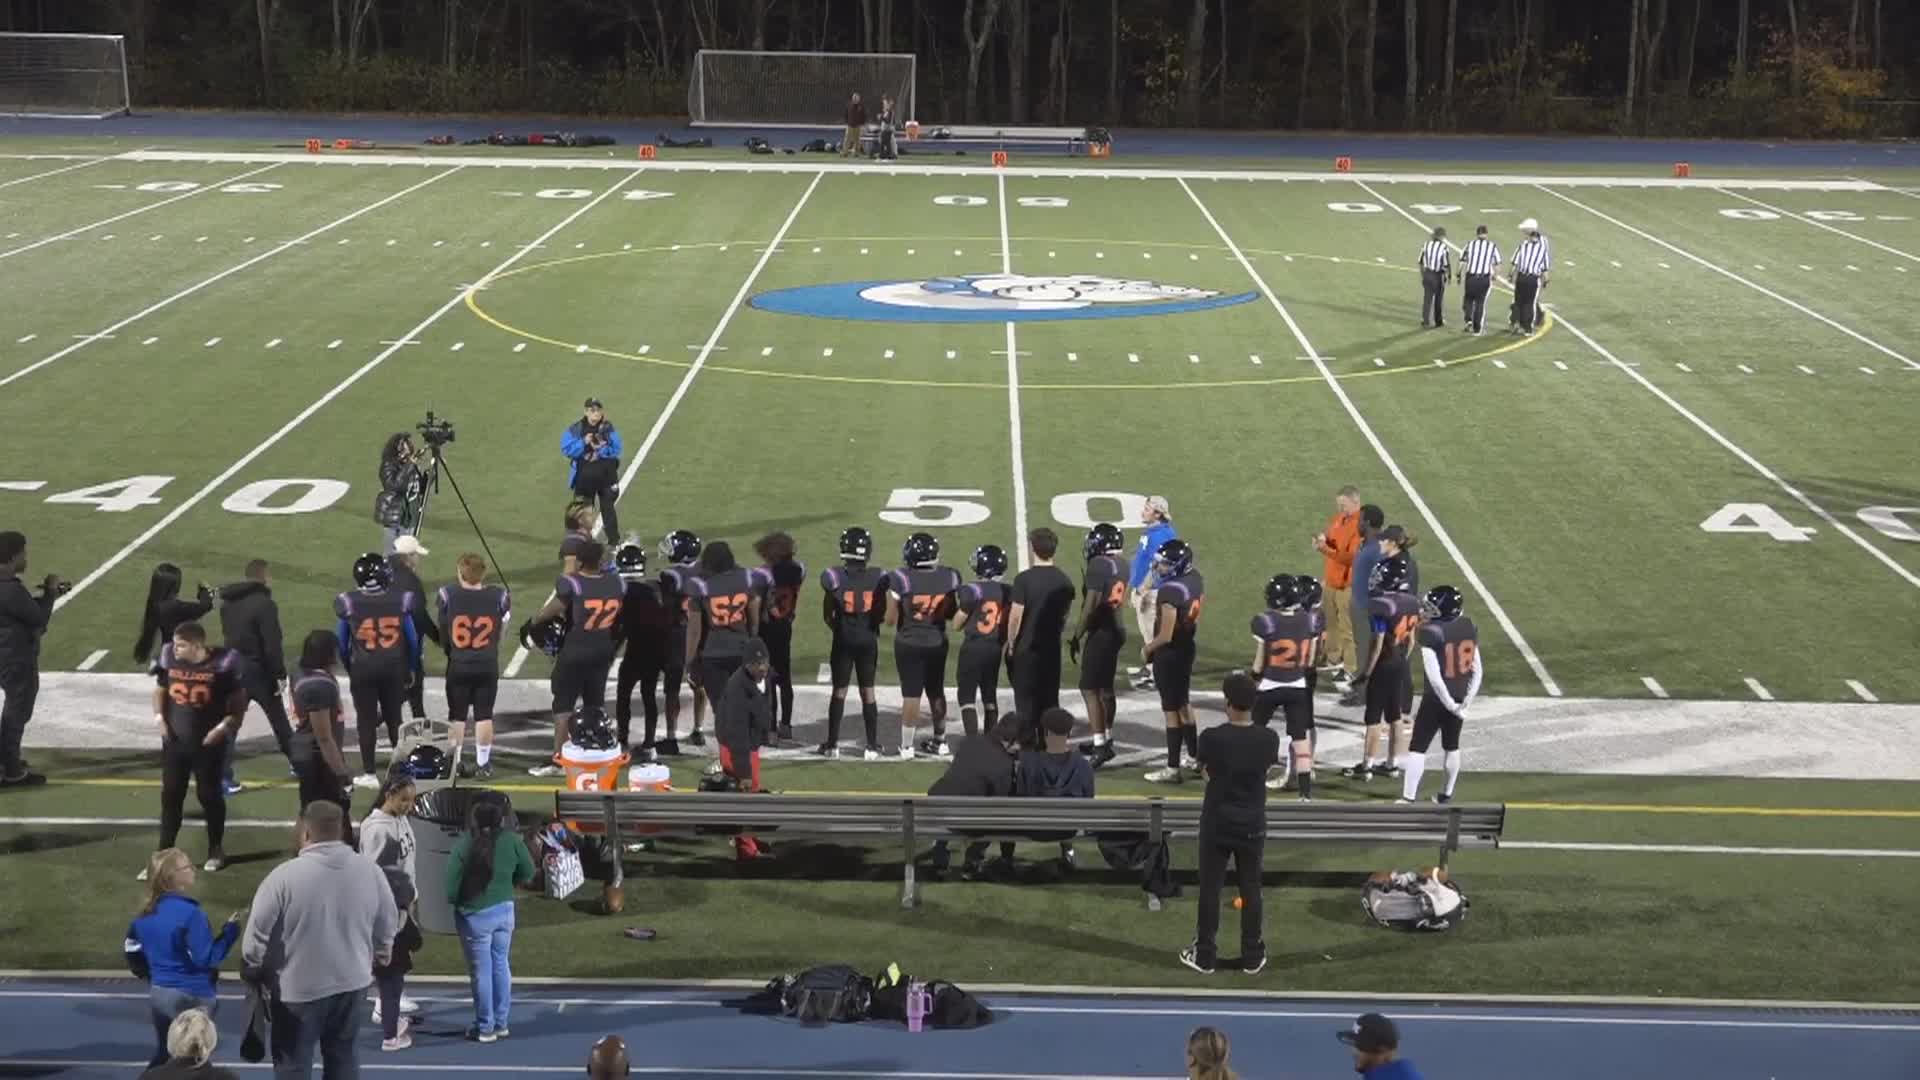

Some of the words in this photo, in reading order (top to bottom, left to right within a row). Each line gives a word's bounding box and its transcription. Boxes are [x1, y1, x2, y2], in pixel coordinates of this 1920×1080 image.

[452, 614, 494, 649] 62
[583, 599, 622, 630] 72
[356, 615, 400, 650] 45
[1269, 638, 1311, 668] 21
[1444, 639, 1475, 678] 18
